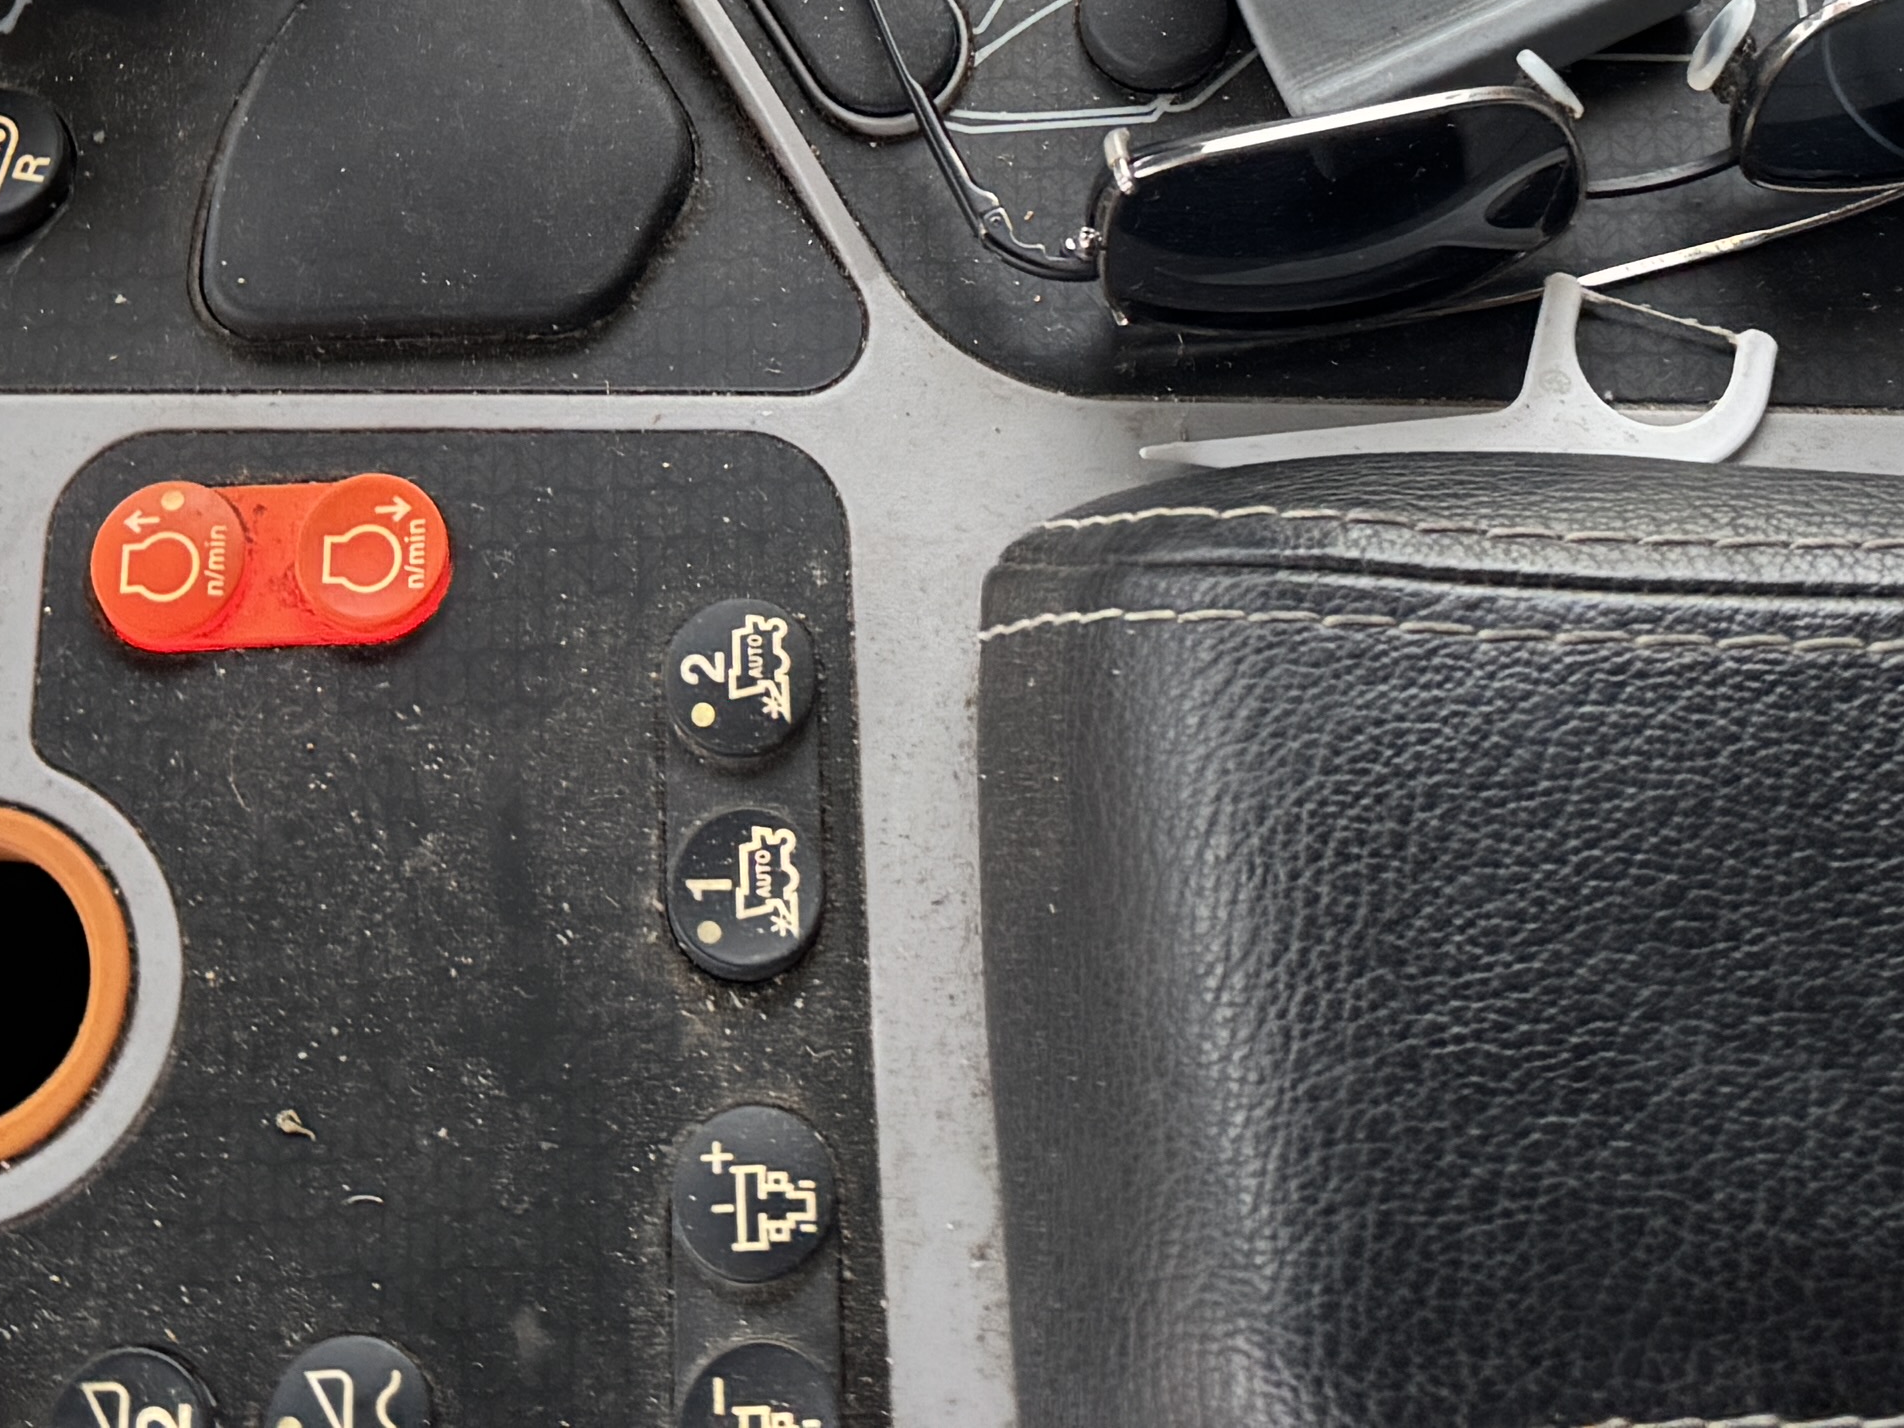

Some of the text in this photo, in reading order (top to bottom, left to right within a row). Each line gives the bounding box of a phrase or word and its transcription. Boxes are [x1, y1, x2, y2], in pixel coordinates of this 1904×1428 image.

[12, 154, 51, 183] R
[206, 524, 228, 597] n/min
[404, 517, 427, 589] n/min
[680, 651, 725, 685] 2
[747, 633, 764, 678] AUTO
[685, 878, 733, 901] 1
[754, 849, 772, 898] AUTO
